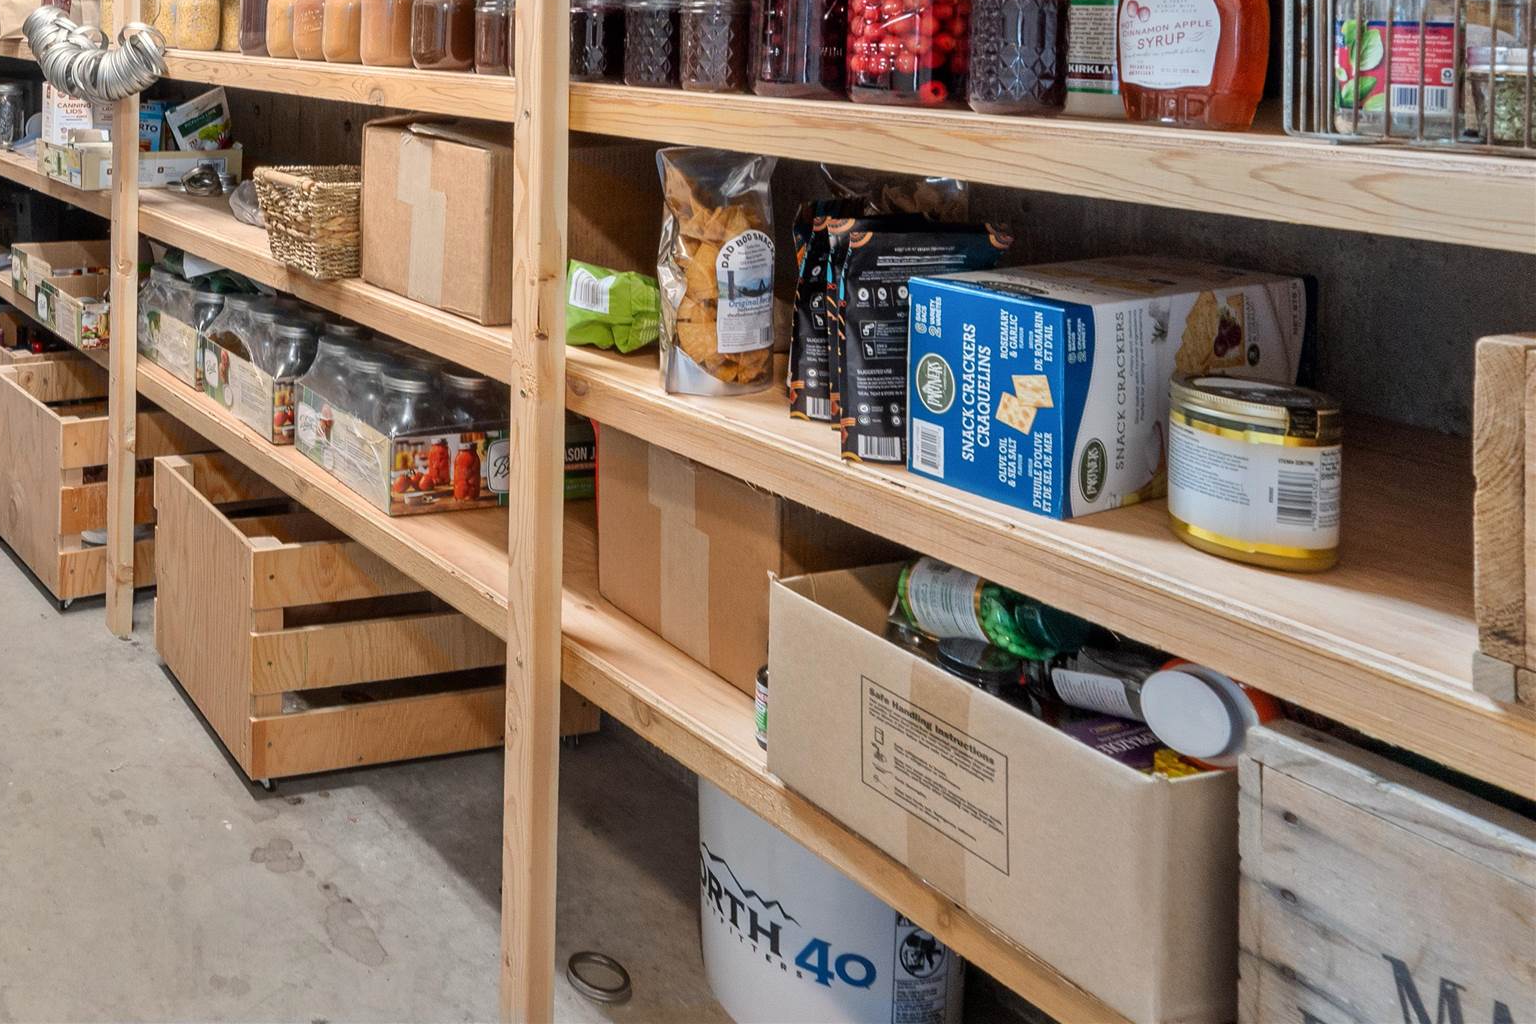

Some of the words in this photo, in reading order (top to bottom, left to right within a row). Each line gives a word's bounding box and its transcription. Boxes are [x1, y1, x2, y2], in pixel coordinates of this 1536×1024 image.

[1121, 20, 1134, 30] HOT
[1122, 24, 1169, 38] CINNAMON
[1174, 19, 1213, 29] APPLE
[1136, 31, 1186, 50] SYRUP
[721, 244, 735, 269] DAD
[735, 233, 753, 248] BOD
[728, 297, 759, 308] Original
[915, 322, 927, 334] 6
[928, 326, 942, 339] 2
[1000, 308, 1009, 360] ROSEMARY
[1009, 314, 1019, 349] GARLIC
[1034, 311, 1044, 361] ROMARIN
[1045, 324, 1054, 351] D'AIL
[962, 323, 977, 405] CRACKERS
[1009, 349, 1017, 359] &
[1044, 352, 1053, 362] ET
[1116, 310, 1125, 404] CRACKERS
[1034, 362, 1043, 372] DE
[976, 344, 992, 448] CRAQUELINS
[961, 406, 975, 463] SNACK
[999, 437, 1008, 452] OIL
[1044, 432, 1053, 455] MER
[1115, 407, 1125, 471] SNACK
[1009, 436, 1017, 460] SALT
[1034, 431, 1043, 470] D'OLIVE
[998, 452, 1007, 483] OLIVE
[1008, 460, 1016, 477] SEA
[1044, 454, 1052, 468] DE
[1008, 477, 1016, 488] &
[1043, 468, 1052, 485] SEL
[1033, 469, 1042, 509] D'HUILE
[1043, 485, 1052, 500] DE
[1042, 499, 1052, 513] ET
[868, 687, 890, 705] Safe
[891, 698, 933, 731] Handling
[934, 724, 996, 766] Instructions
[794, 937, 878, 990] 40
